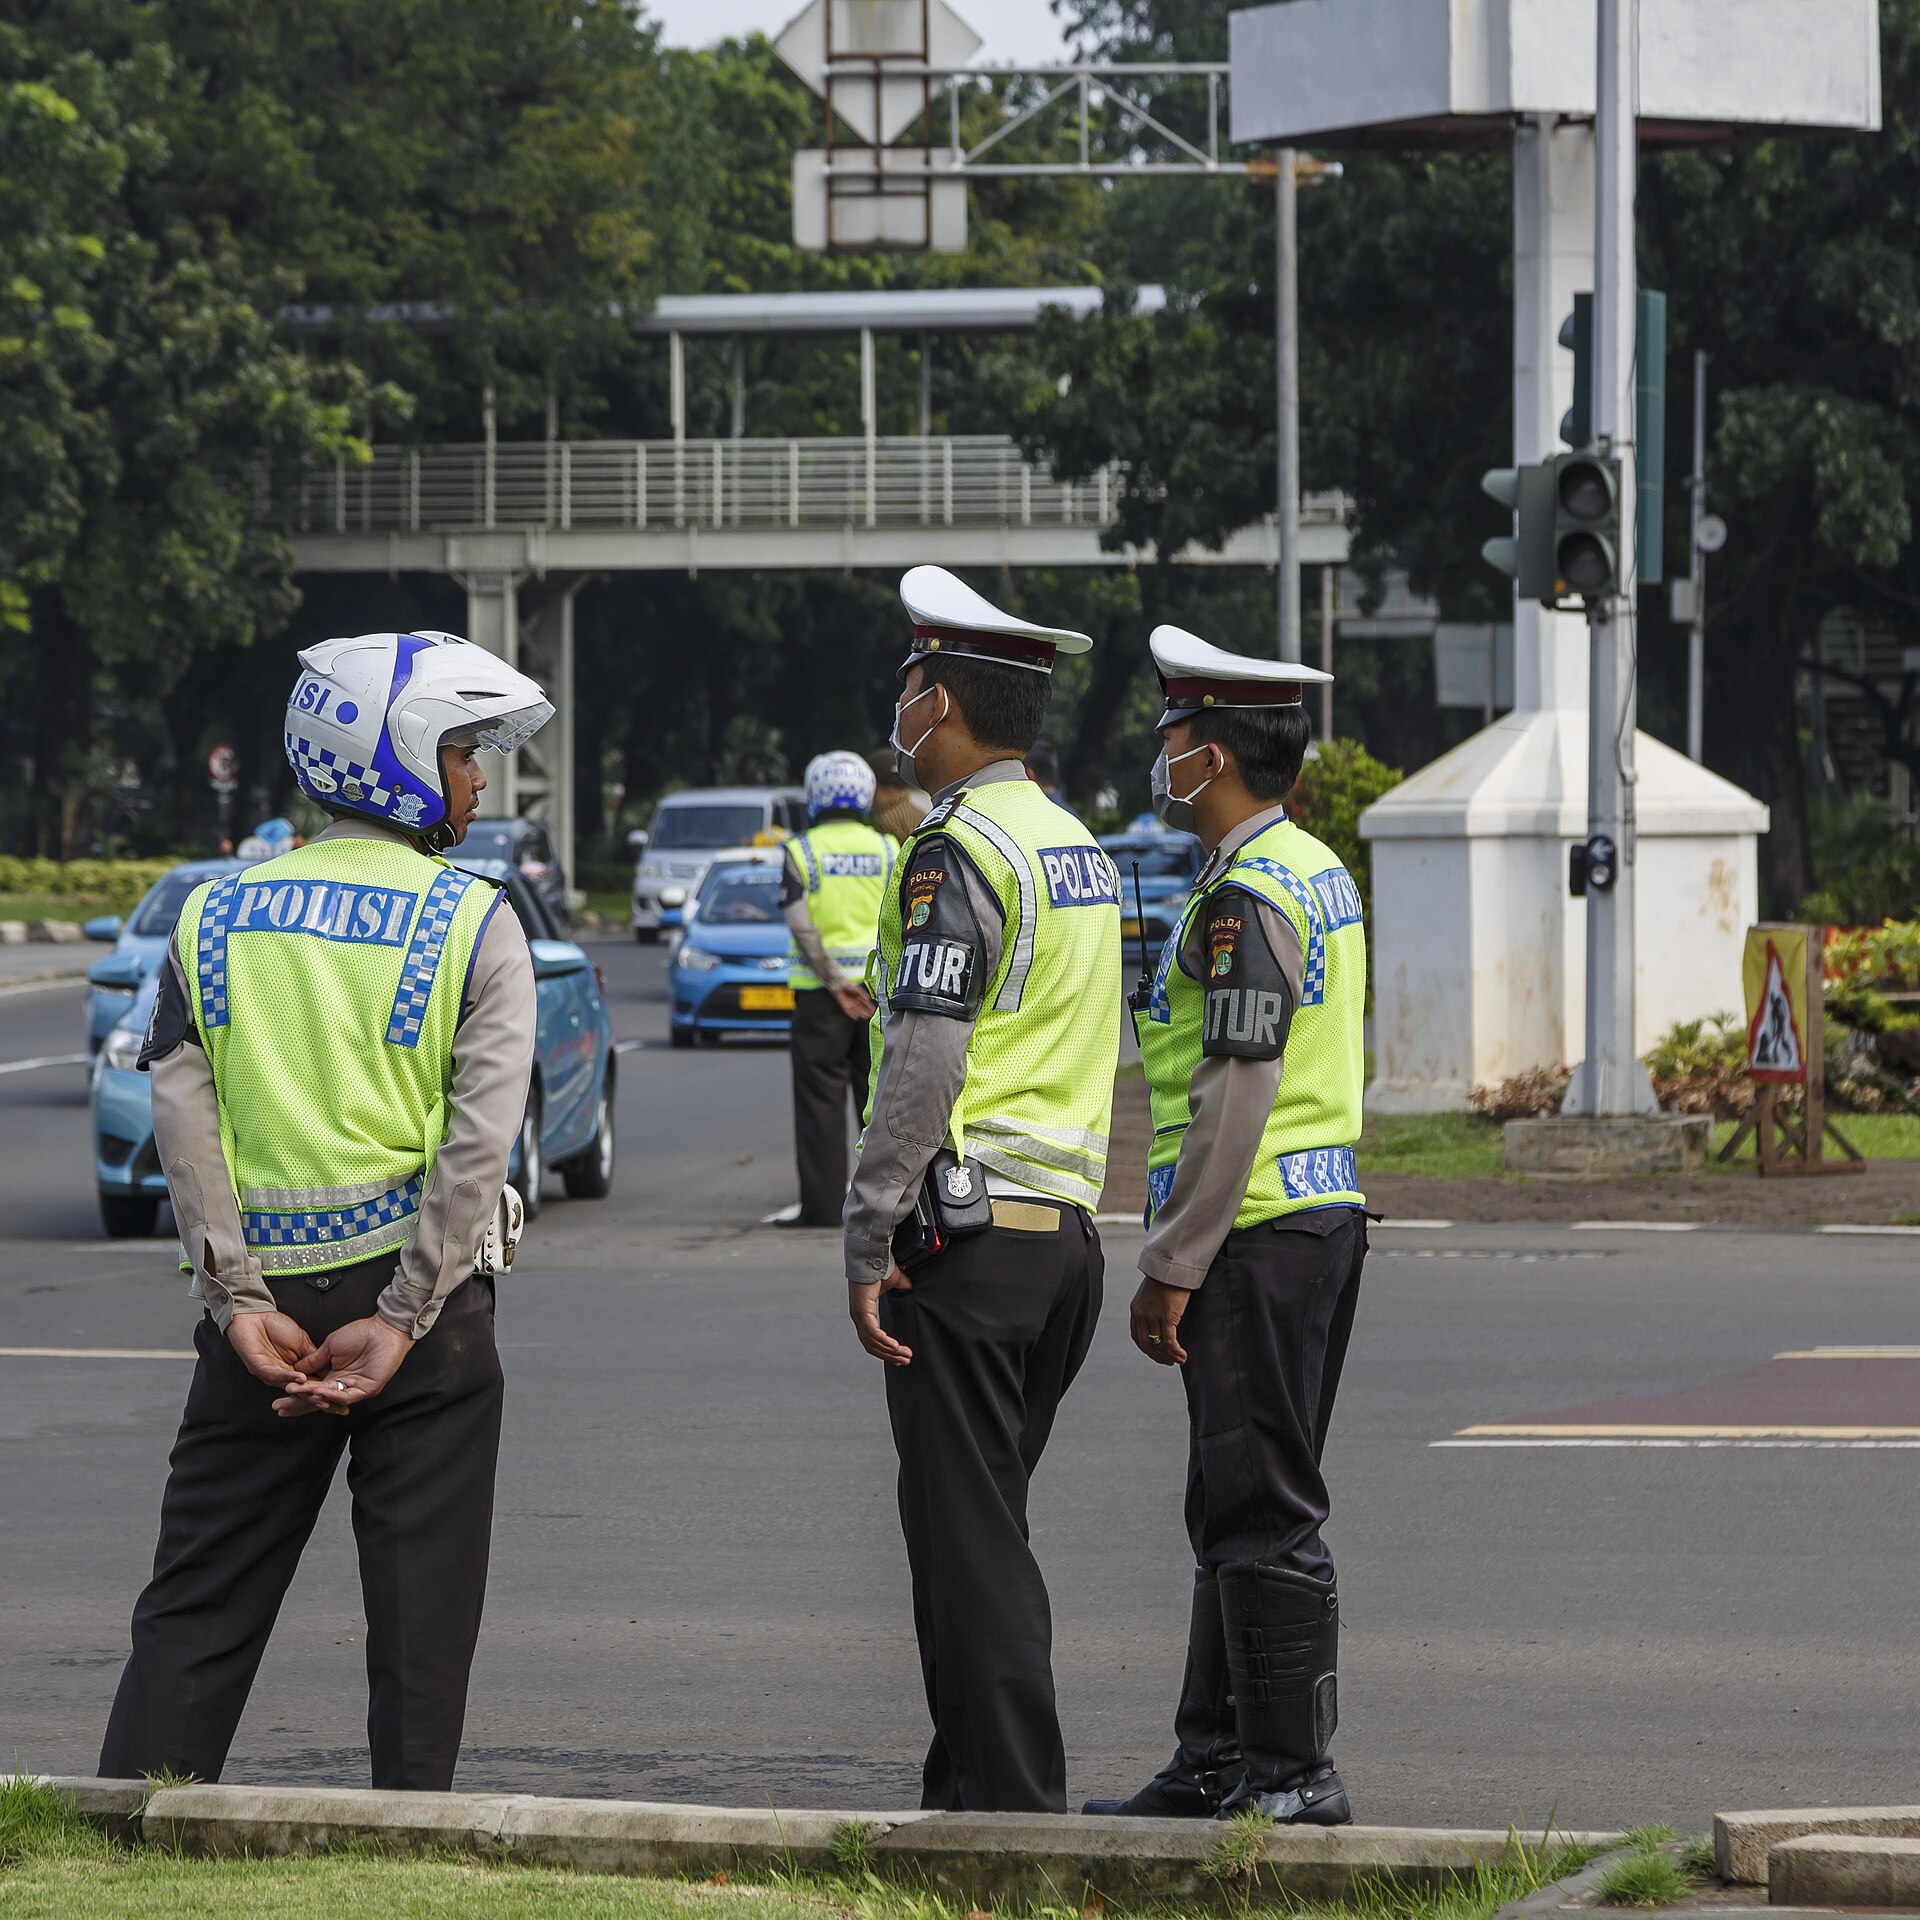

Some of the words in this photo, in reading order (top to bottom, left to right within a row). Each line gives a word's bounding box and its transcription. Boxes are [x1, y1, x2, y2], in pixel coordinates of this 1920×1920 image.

[288, 680, 332, 715] ISI
[911, 871, 943, 885] POLDA
[233, 885, 410, 941] POLISI
[1210, 918, 1241, 931] POLDA
[896, 944, 966, 995] TUR
